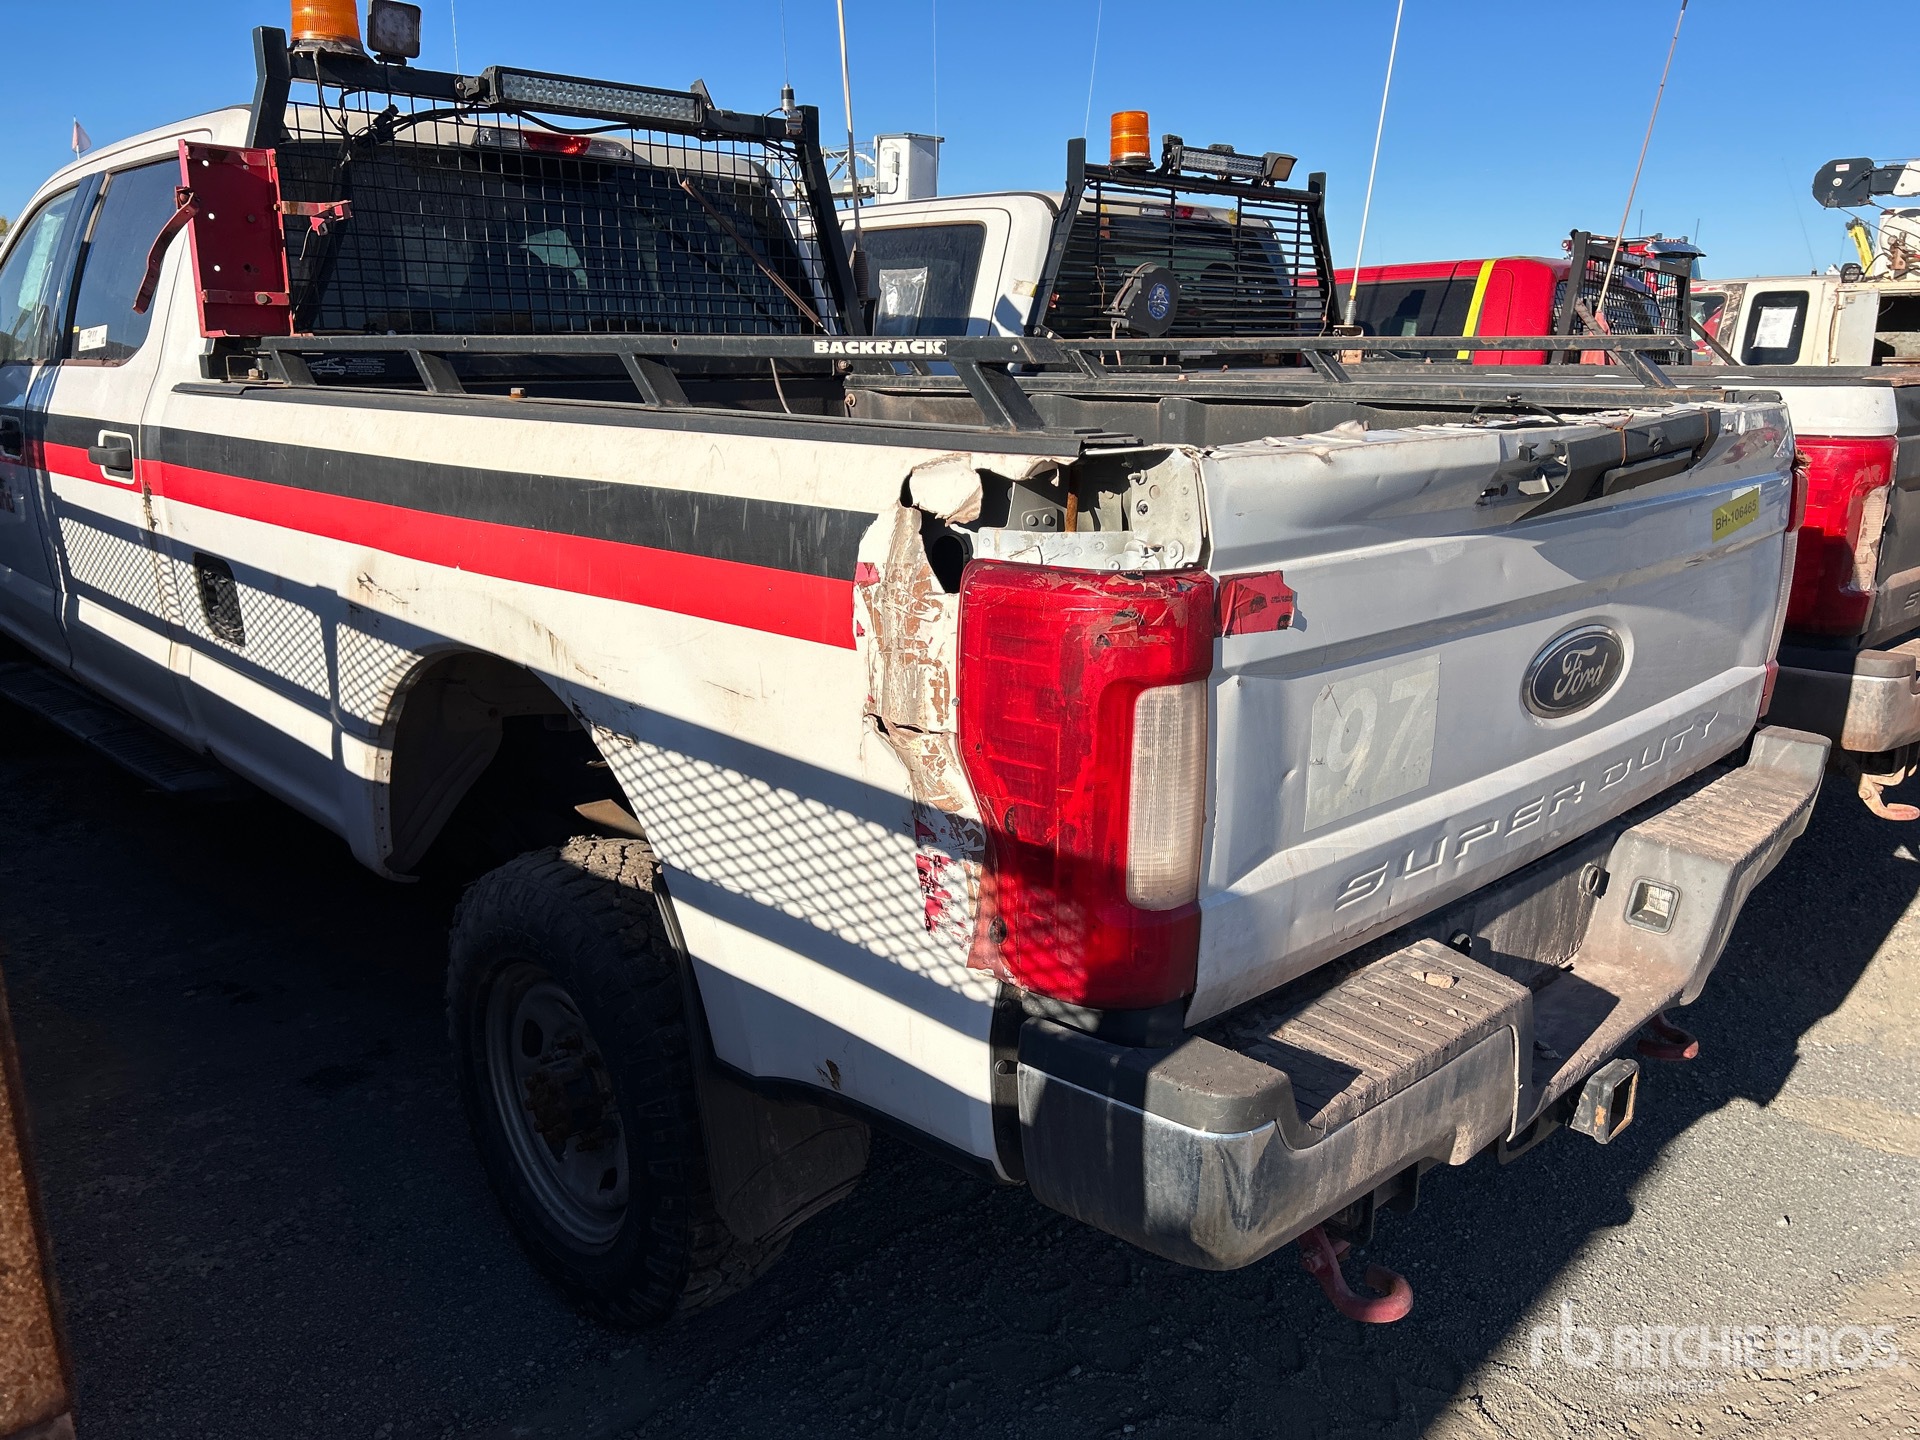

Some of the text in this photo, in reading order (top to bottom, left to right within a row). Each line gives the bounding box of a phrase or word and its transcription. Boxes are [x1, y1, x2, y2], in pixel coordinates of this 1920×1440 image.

[814, 340, 944, 355] BACKRACK
[1715, 499, 1757, 531] BH-106465
[1553, 645, 1608, 701] Ford
[1326, 669, 1436, 806] 97
[1335, 711, 1719, 912] SUPER DUTY
